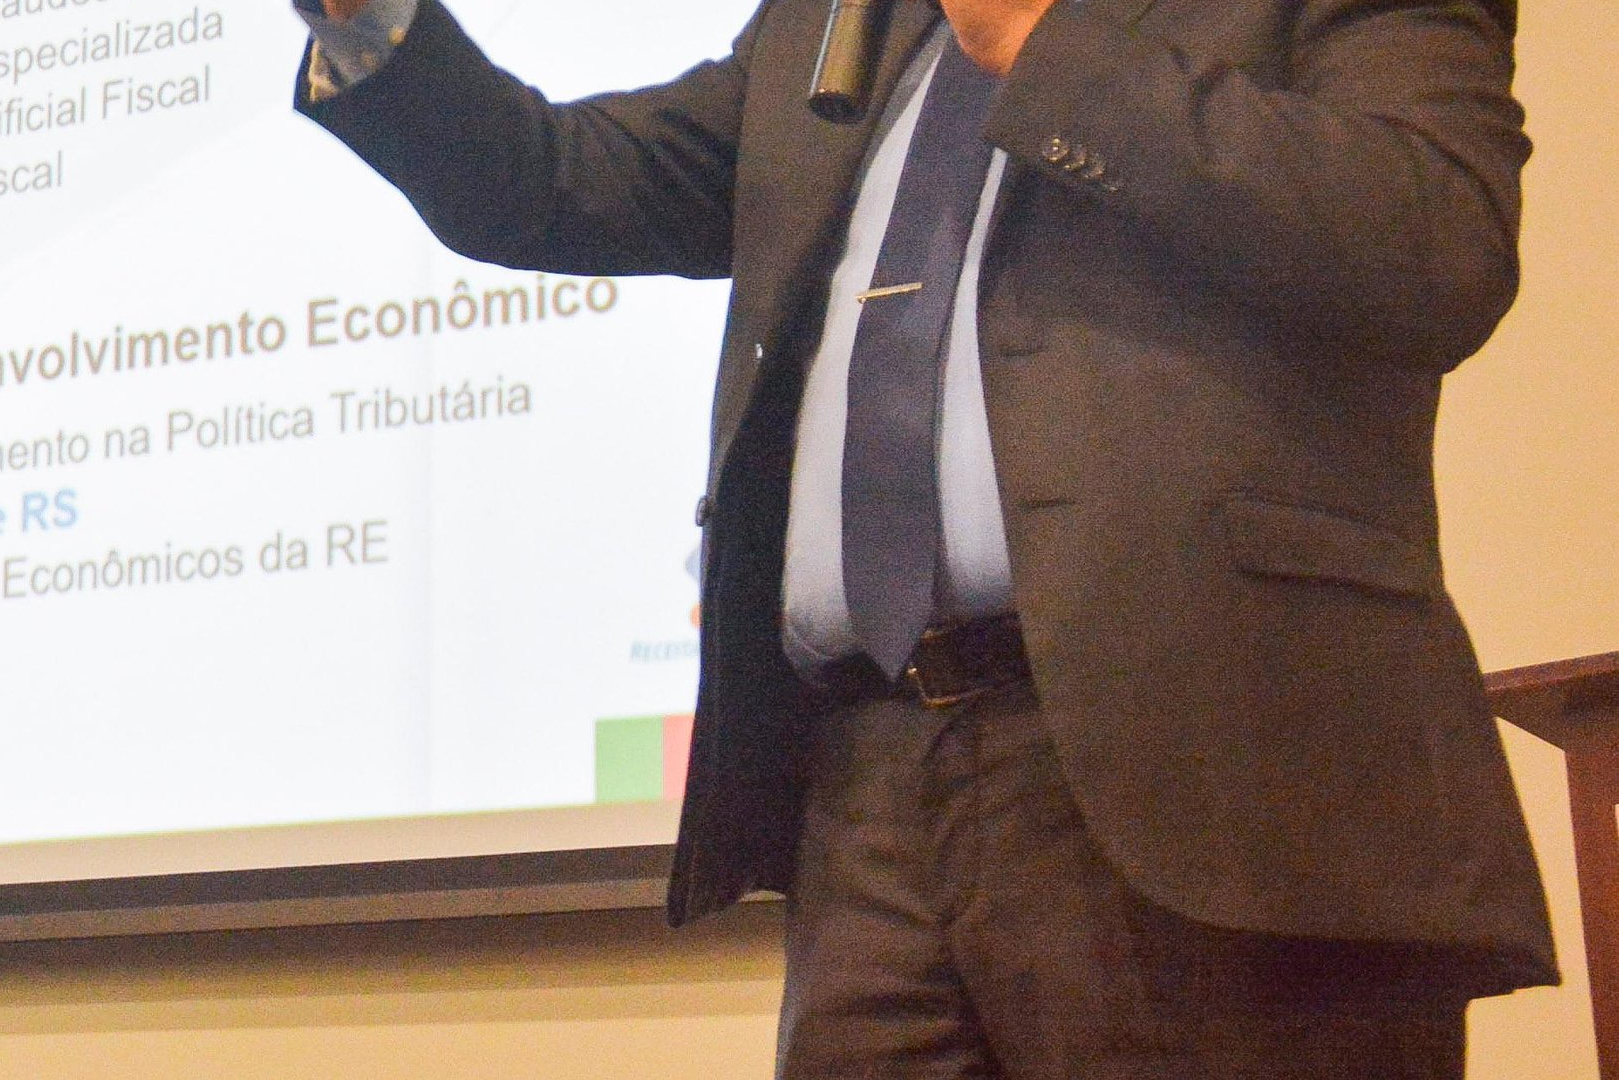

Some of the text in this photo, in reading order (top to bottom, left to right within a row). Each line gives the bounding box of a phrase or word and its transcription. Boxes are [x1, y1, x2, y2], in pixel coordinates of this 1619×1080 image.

[101, 63, 211, 120] Fiscal
[306, 274, 618, 348] Econômico
[104, 425, 151, 459] na
[167, 405, 315, 452] Política
[330, 375, 533, 433] Tributária
[21, 487, 80, 533] RS
[2, 544, 246, 600] Econômicos
[258, 531, 309, 573] da
[326, 519, 388, 567] RE
